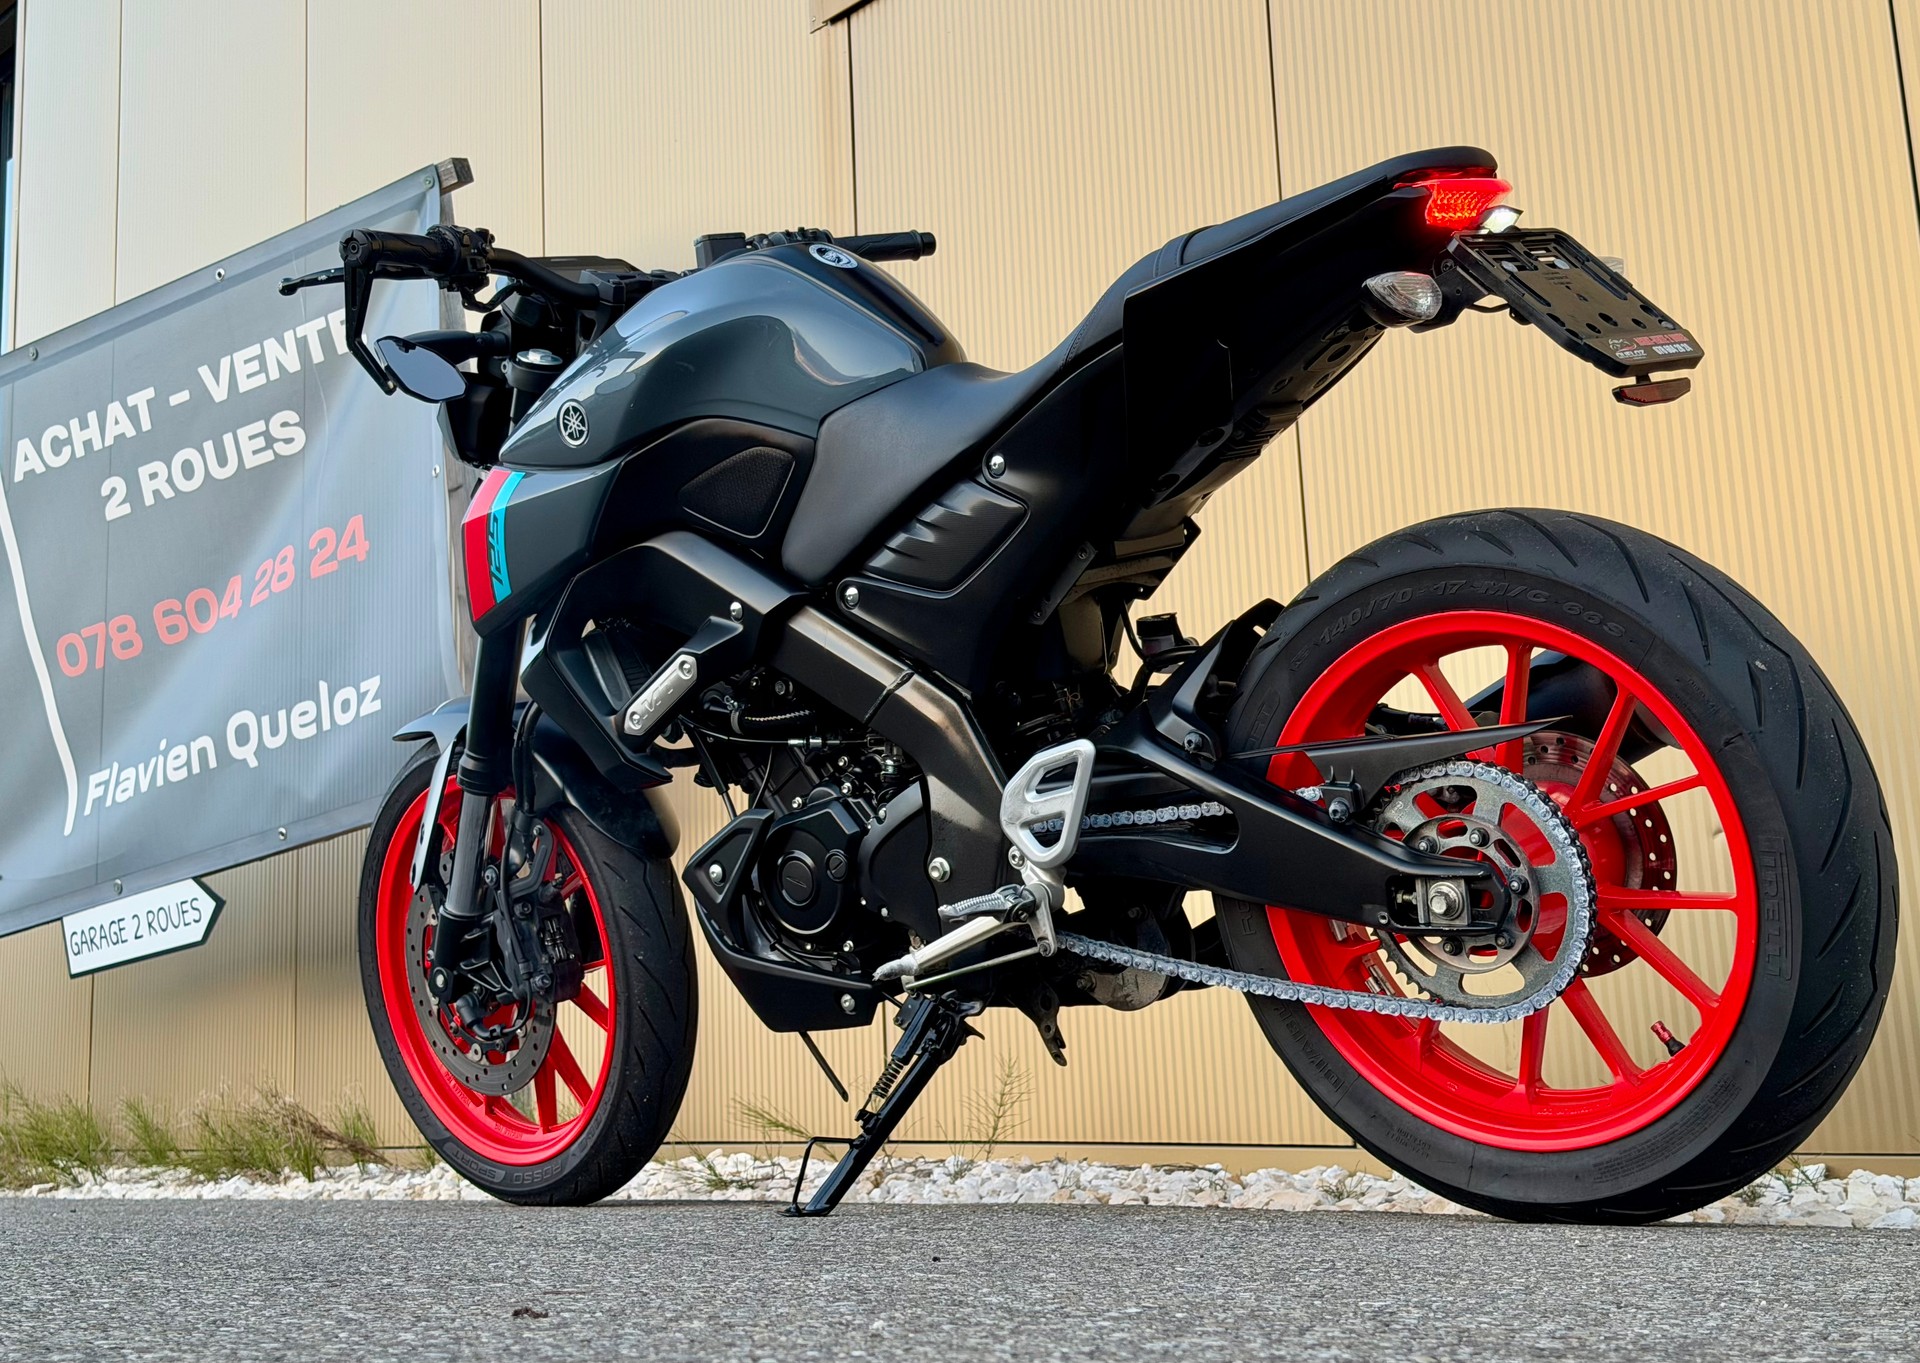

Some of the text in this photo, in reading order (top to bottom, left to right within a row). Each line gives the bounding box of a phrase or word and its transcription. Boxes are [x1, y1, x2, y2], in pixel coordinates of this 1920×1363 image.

[13, 387, 155, 483] ACHAT
[100, 410, 306, 521] 2 ROUES
[56, 514, 370, 677] 078 604 28 24
[83, 674, 382, 816] Flavien Queloz
[70, 897, 202, 956] GARAGE 2 ROUES
